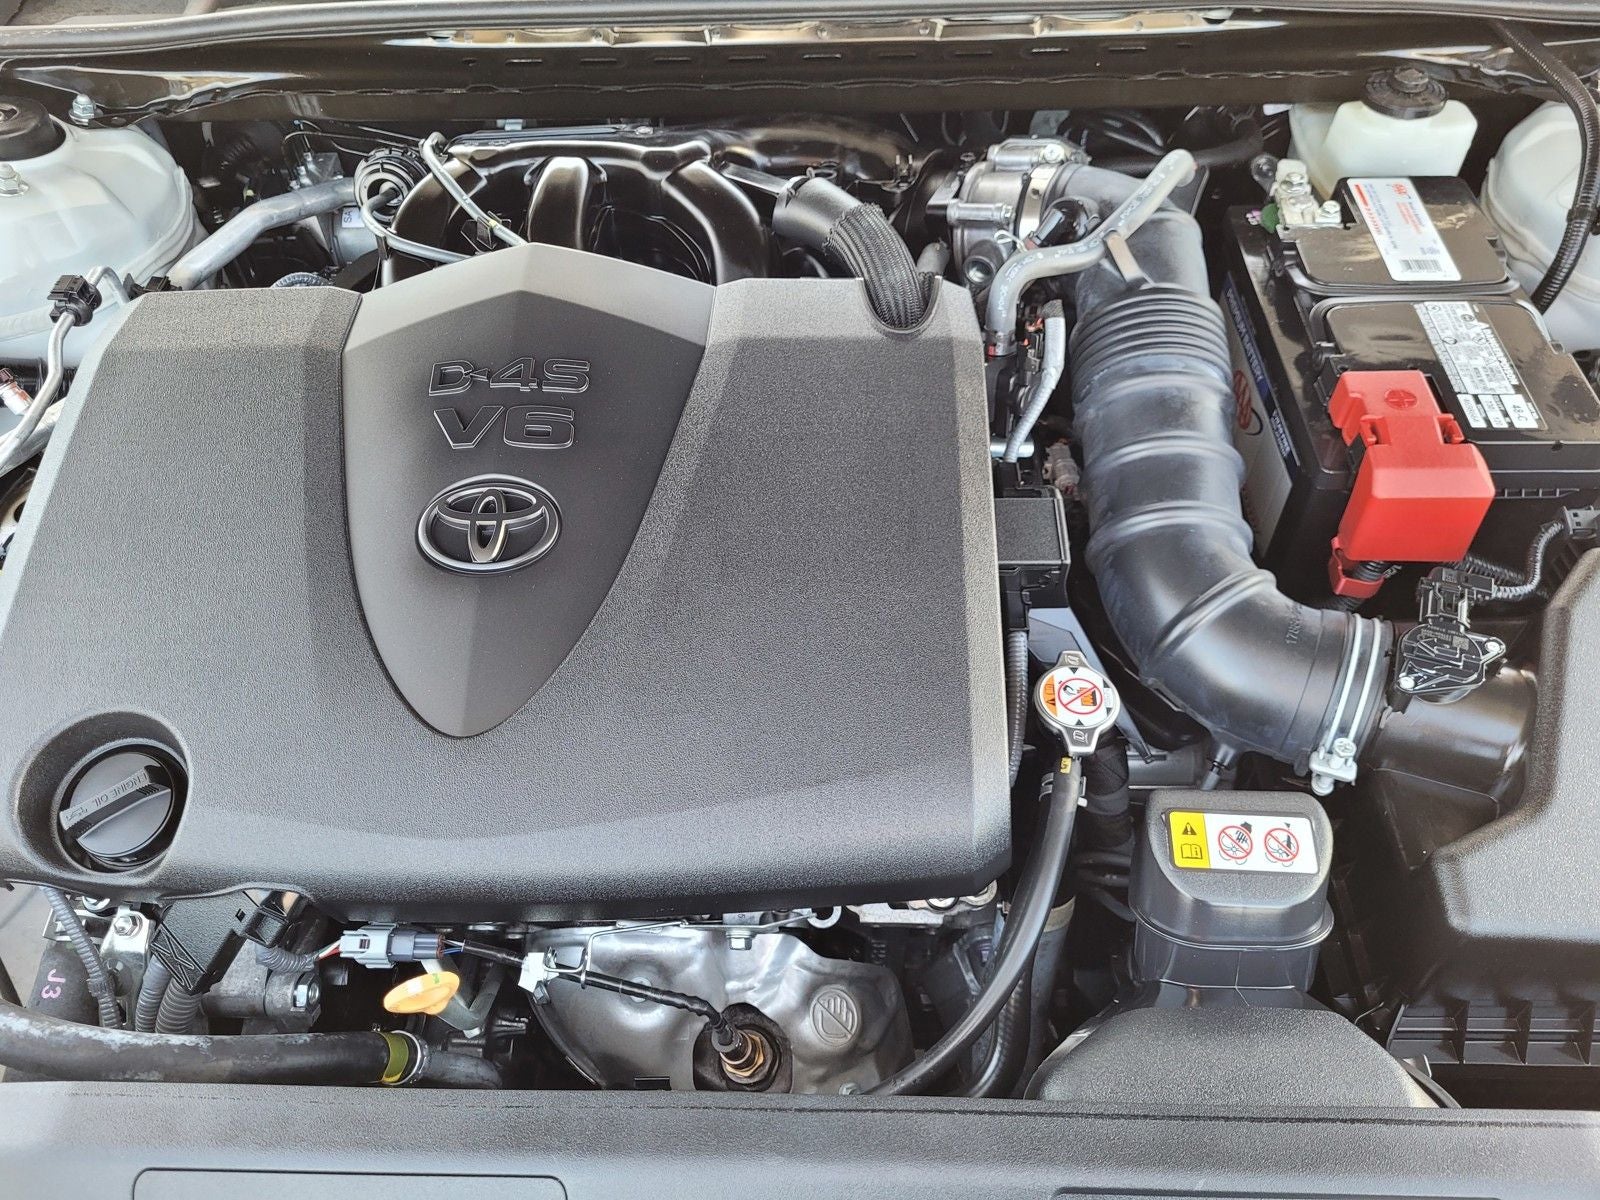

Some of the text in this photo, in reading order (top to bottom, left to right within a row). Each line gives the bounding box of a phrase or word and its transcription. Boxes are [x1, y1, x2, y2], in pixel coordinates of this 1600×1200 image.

[433, 404, 575, 450] V6
[94, 772, 148, 807] ENGINE OIL
[40, 968, 66, 999] J3
